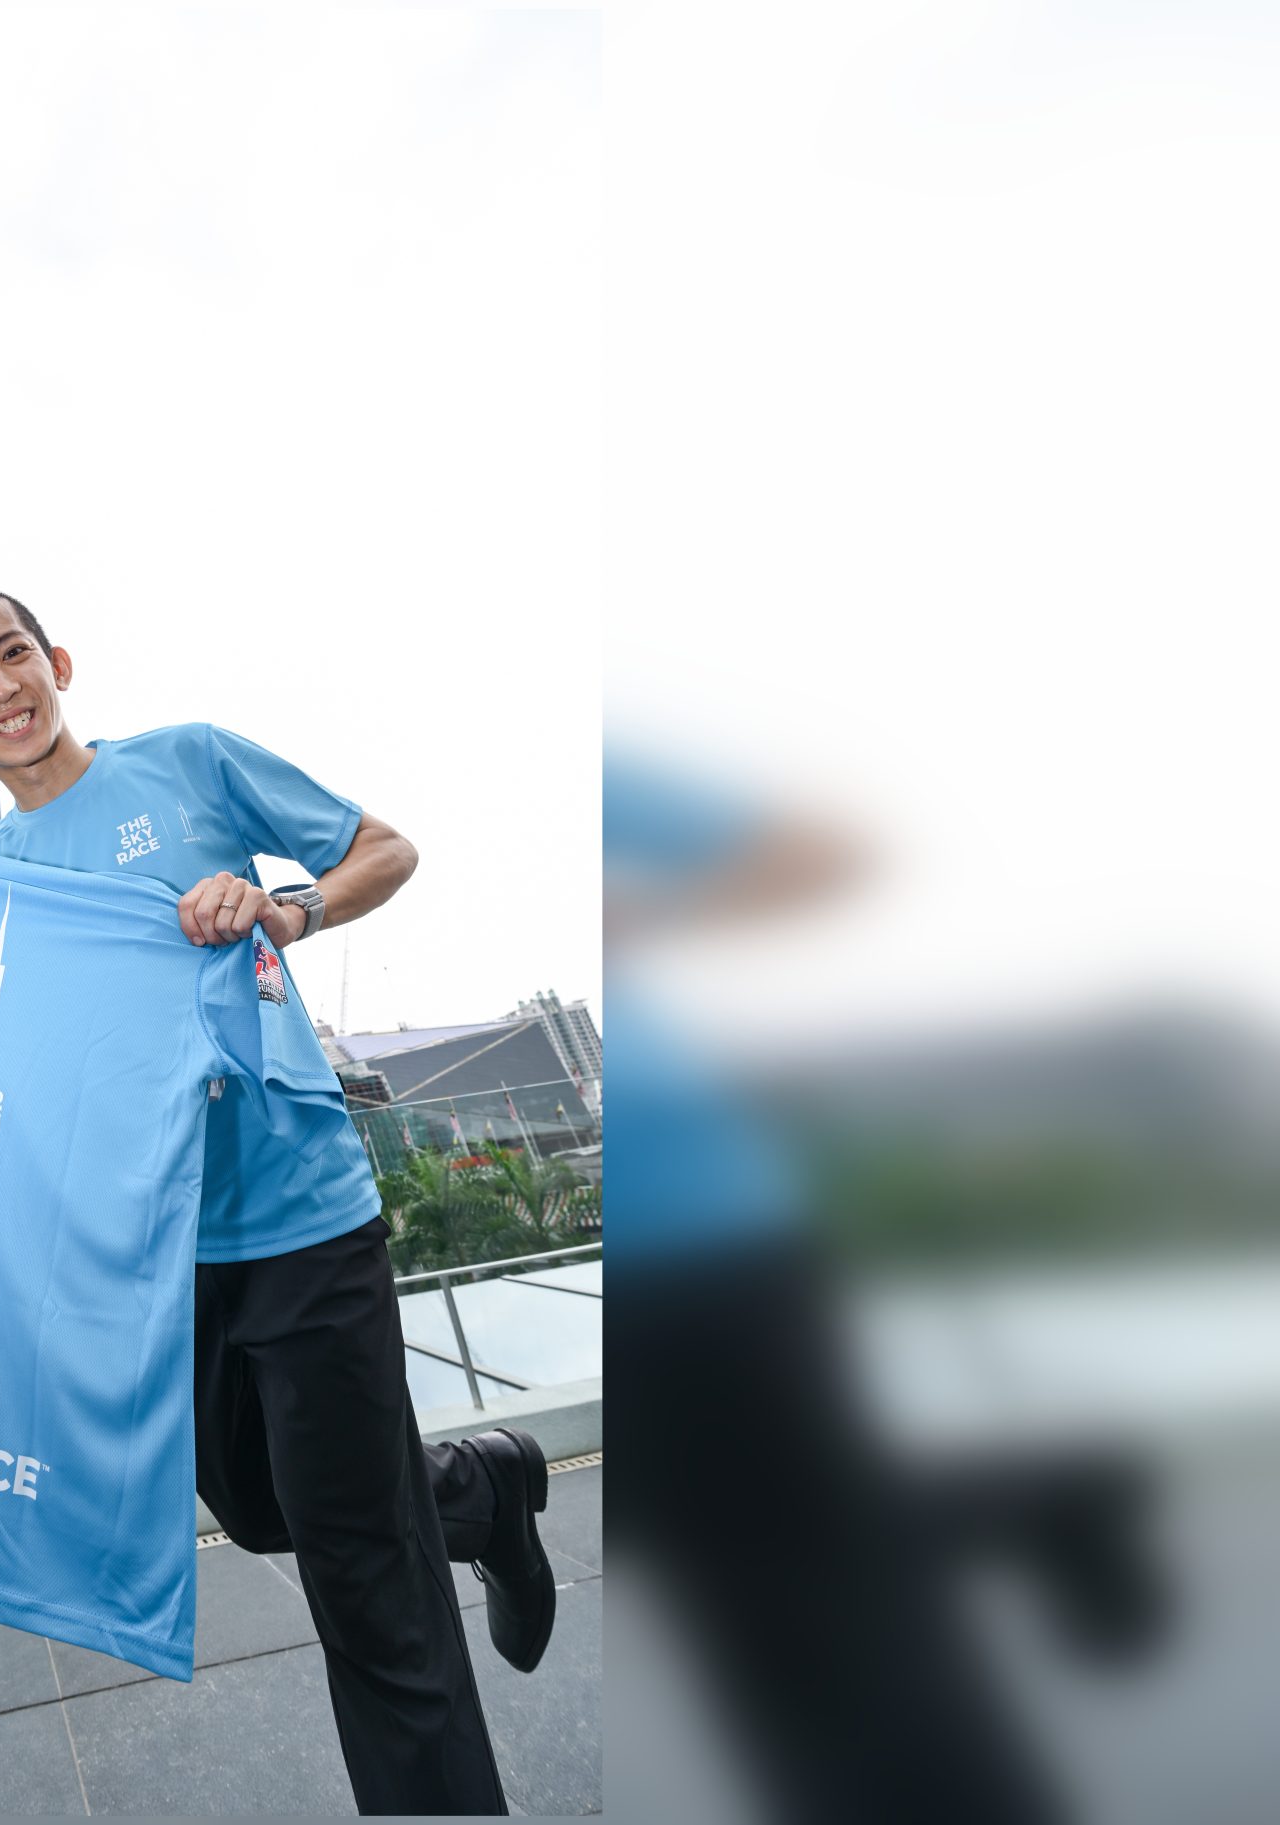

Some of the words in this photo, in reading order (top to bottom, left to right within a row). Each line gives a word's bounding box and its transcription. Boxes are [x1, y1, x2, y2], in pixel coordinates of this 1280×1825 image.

[116, 814, 152, 836] THE
[120, 825, 152, 849] SKY
[116, 837, 161, 865] RACE
